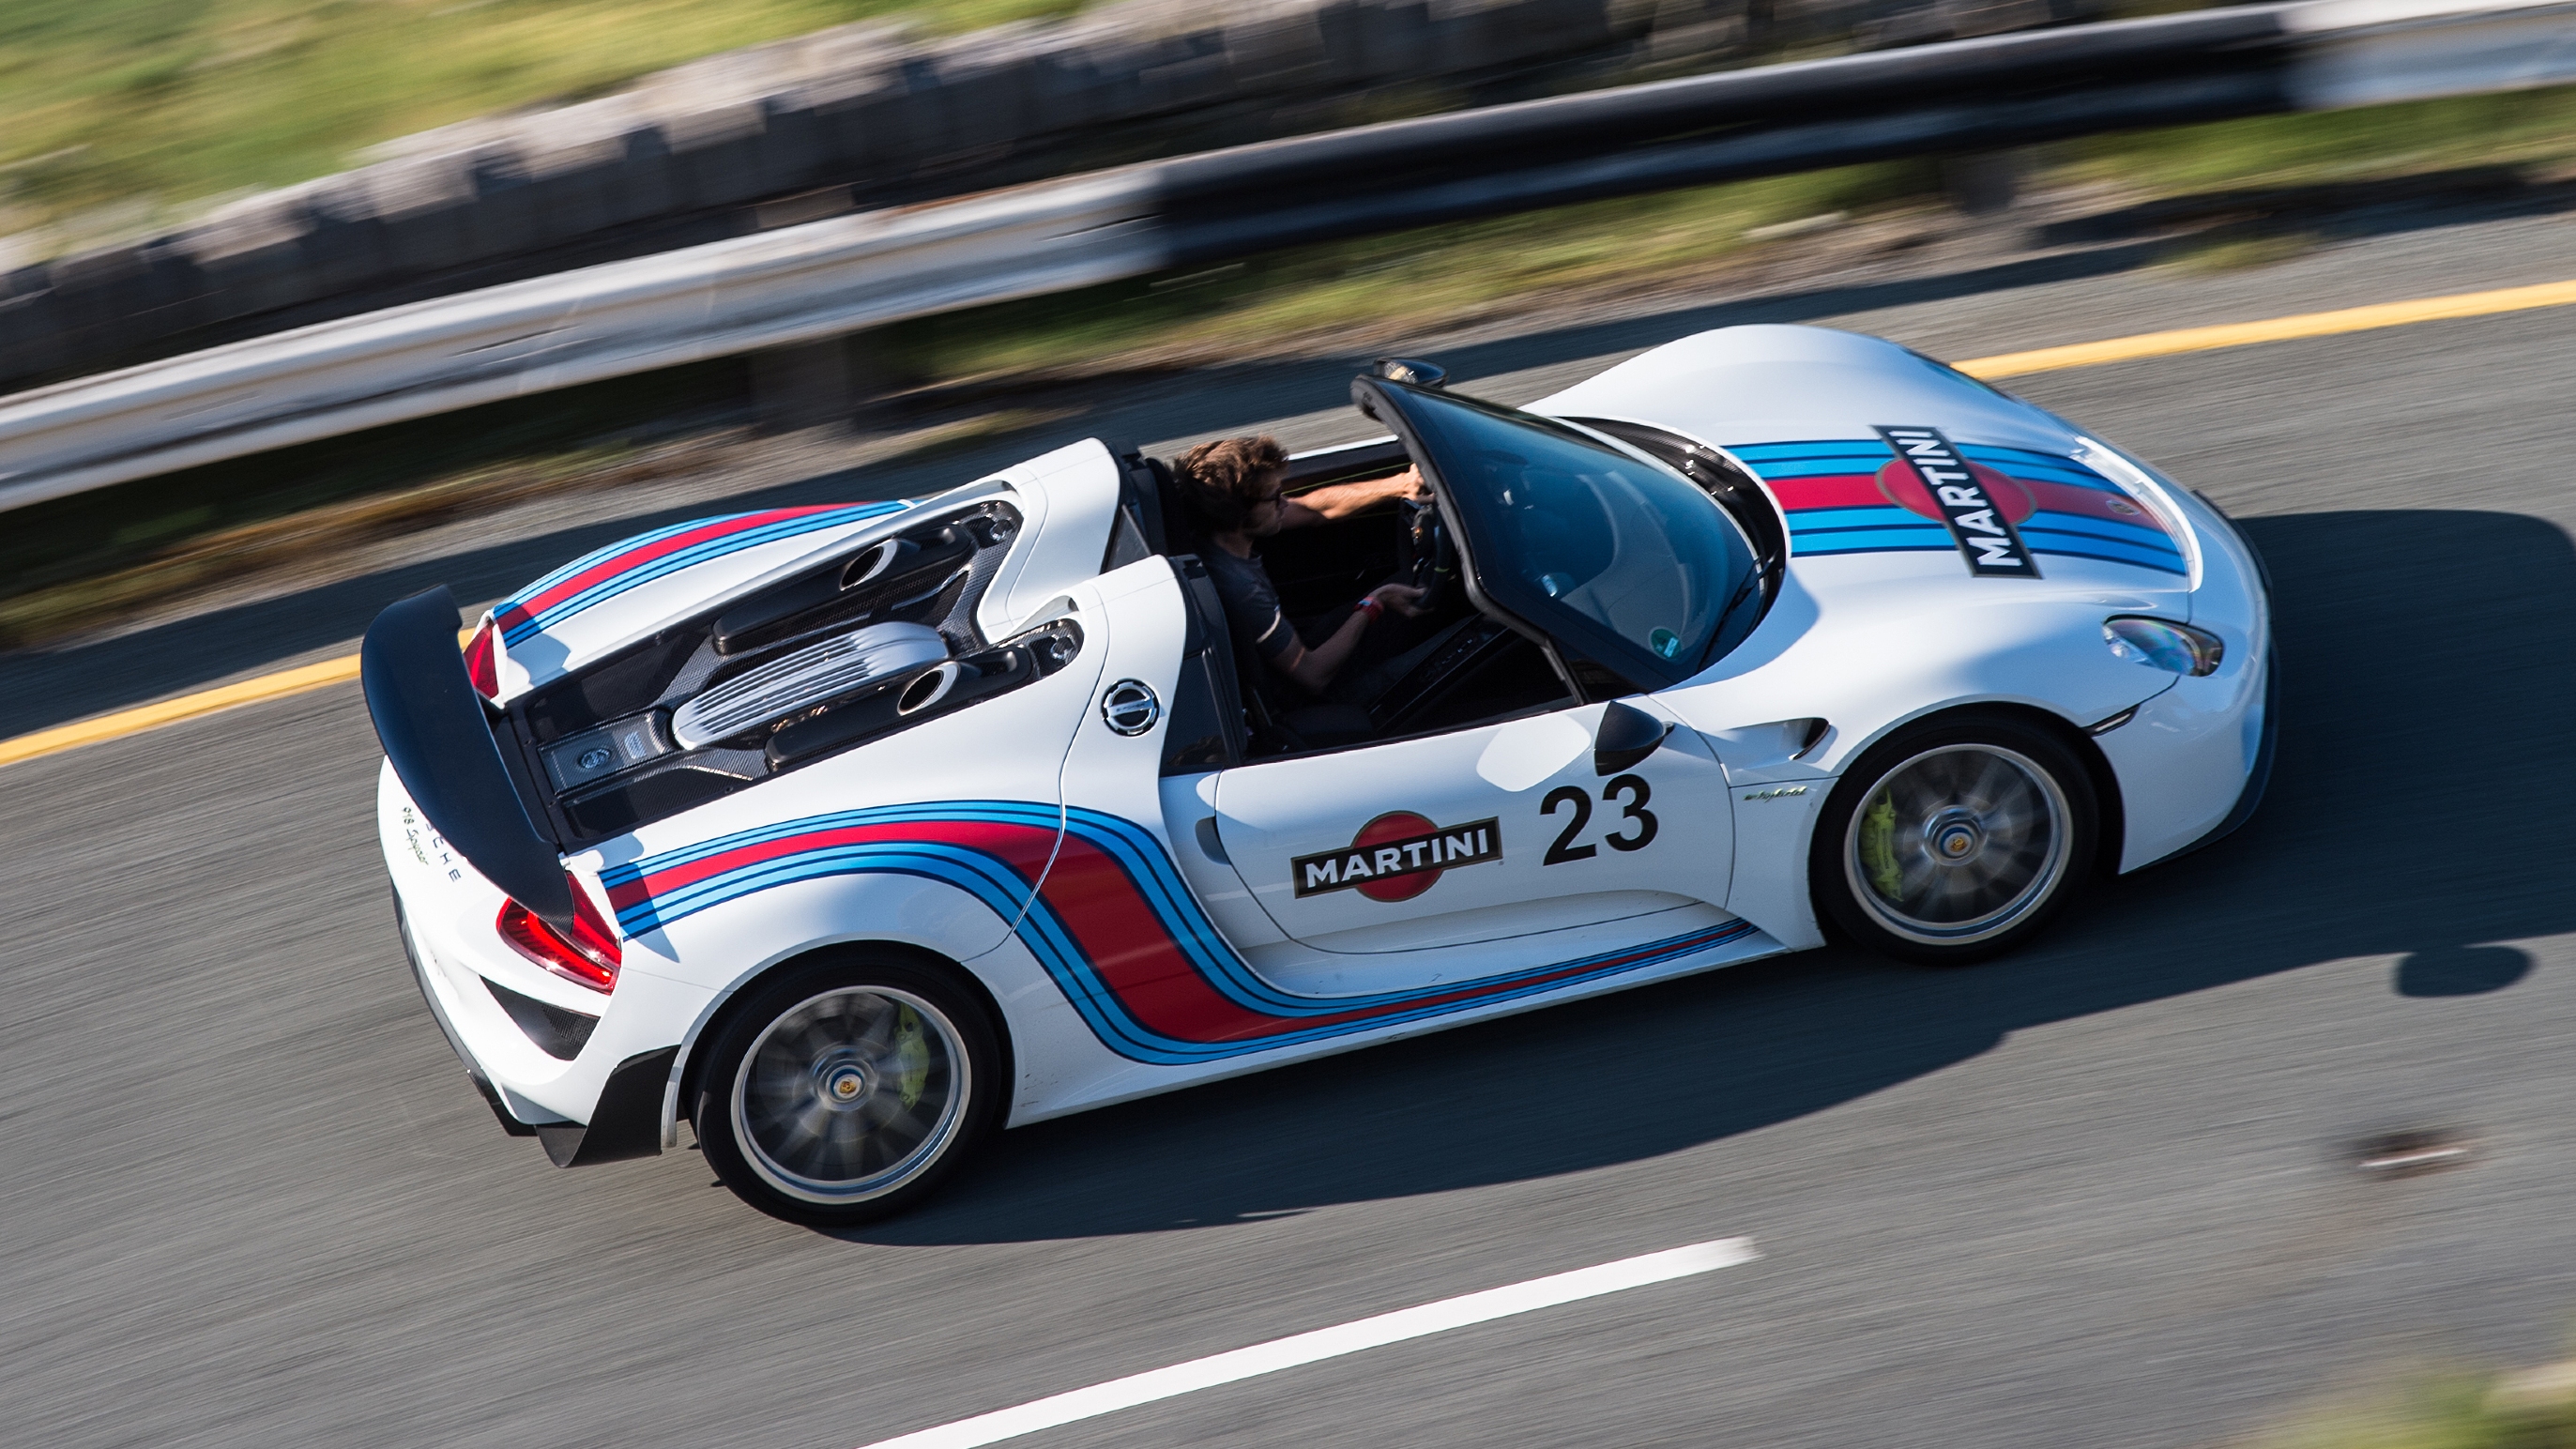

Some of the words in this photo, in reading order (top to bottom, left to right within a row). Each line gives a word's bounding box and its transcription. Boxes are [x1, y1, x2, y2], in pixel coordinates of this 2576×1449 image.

[1887, 430, 2023, 567] MARTINI
[1305, 828, 1489, 889] MARTINI
[1540, 773, 1659, 867] 23
